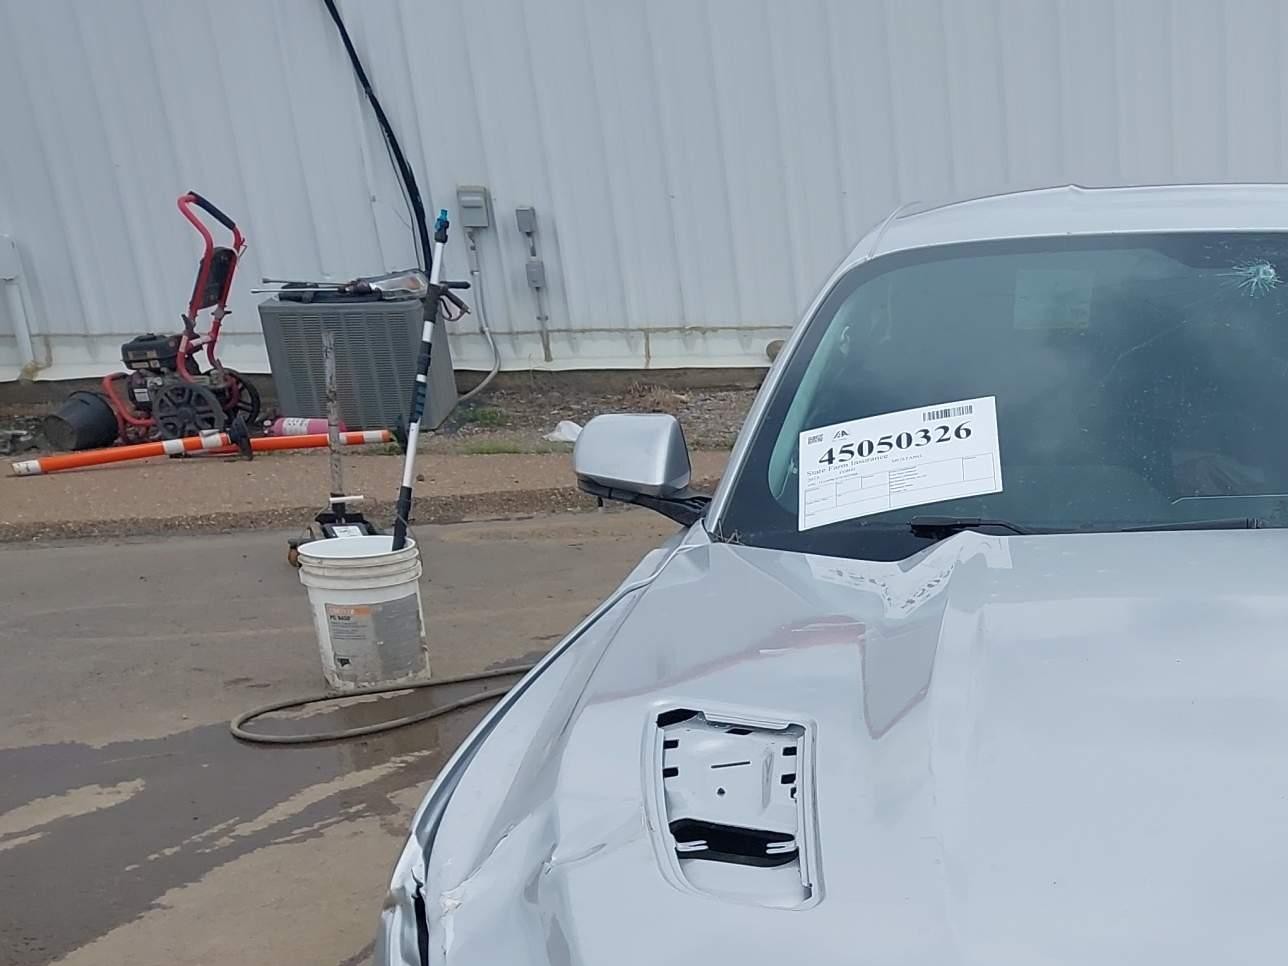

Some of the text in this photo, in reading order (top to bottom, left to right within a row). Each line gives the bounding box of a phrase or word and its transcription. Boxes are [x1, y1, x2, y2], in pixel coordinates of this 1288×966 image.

[818, 421, 973, 465] 45050326
[807, 454, 889, 477] State Farm Insurance
